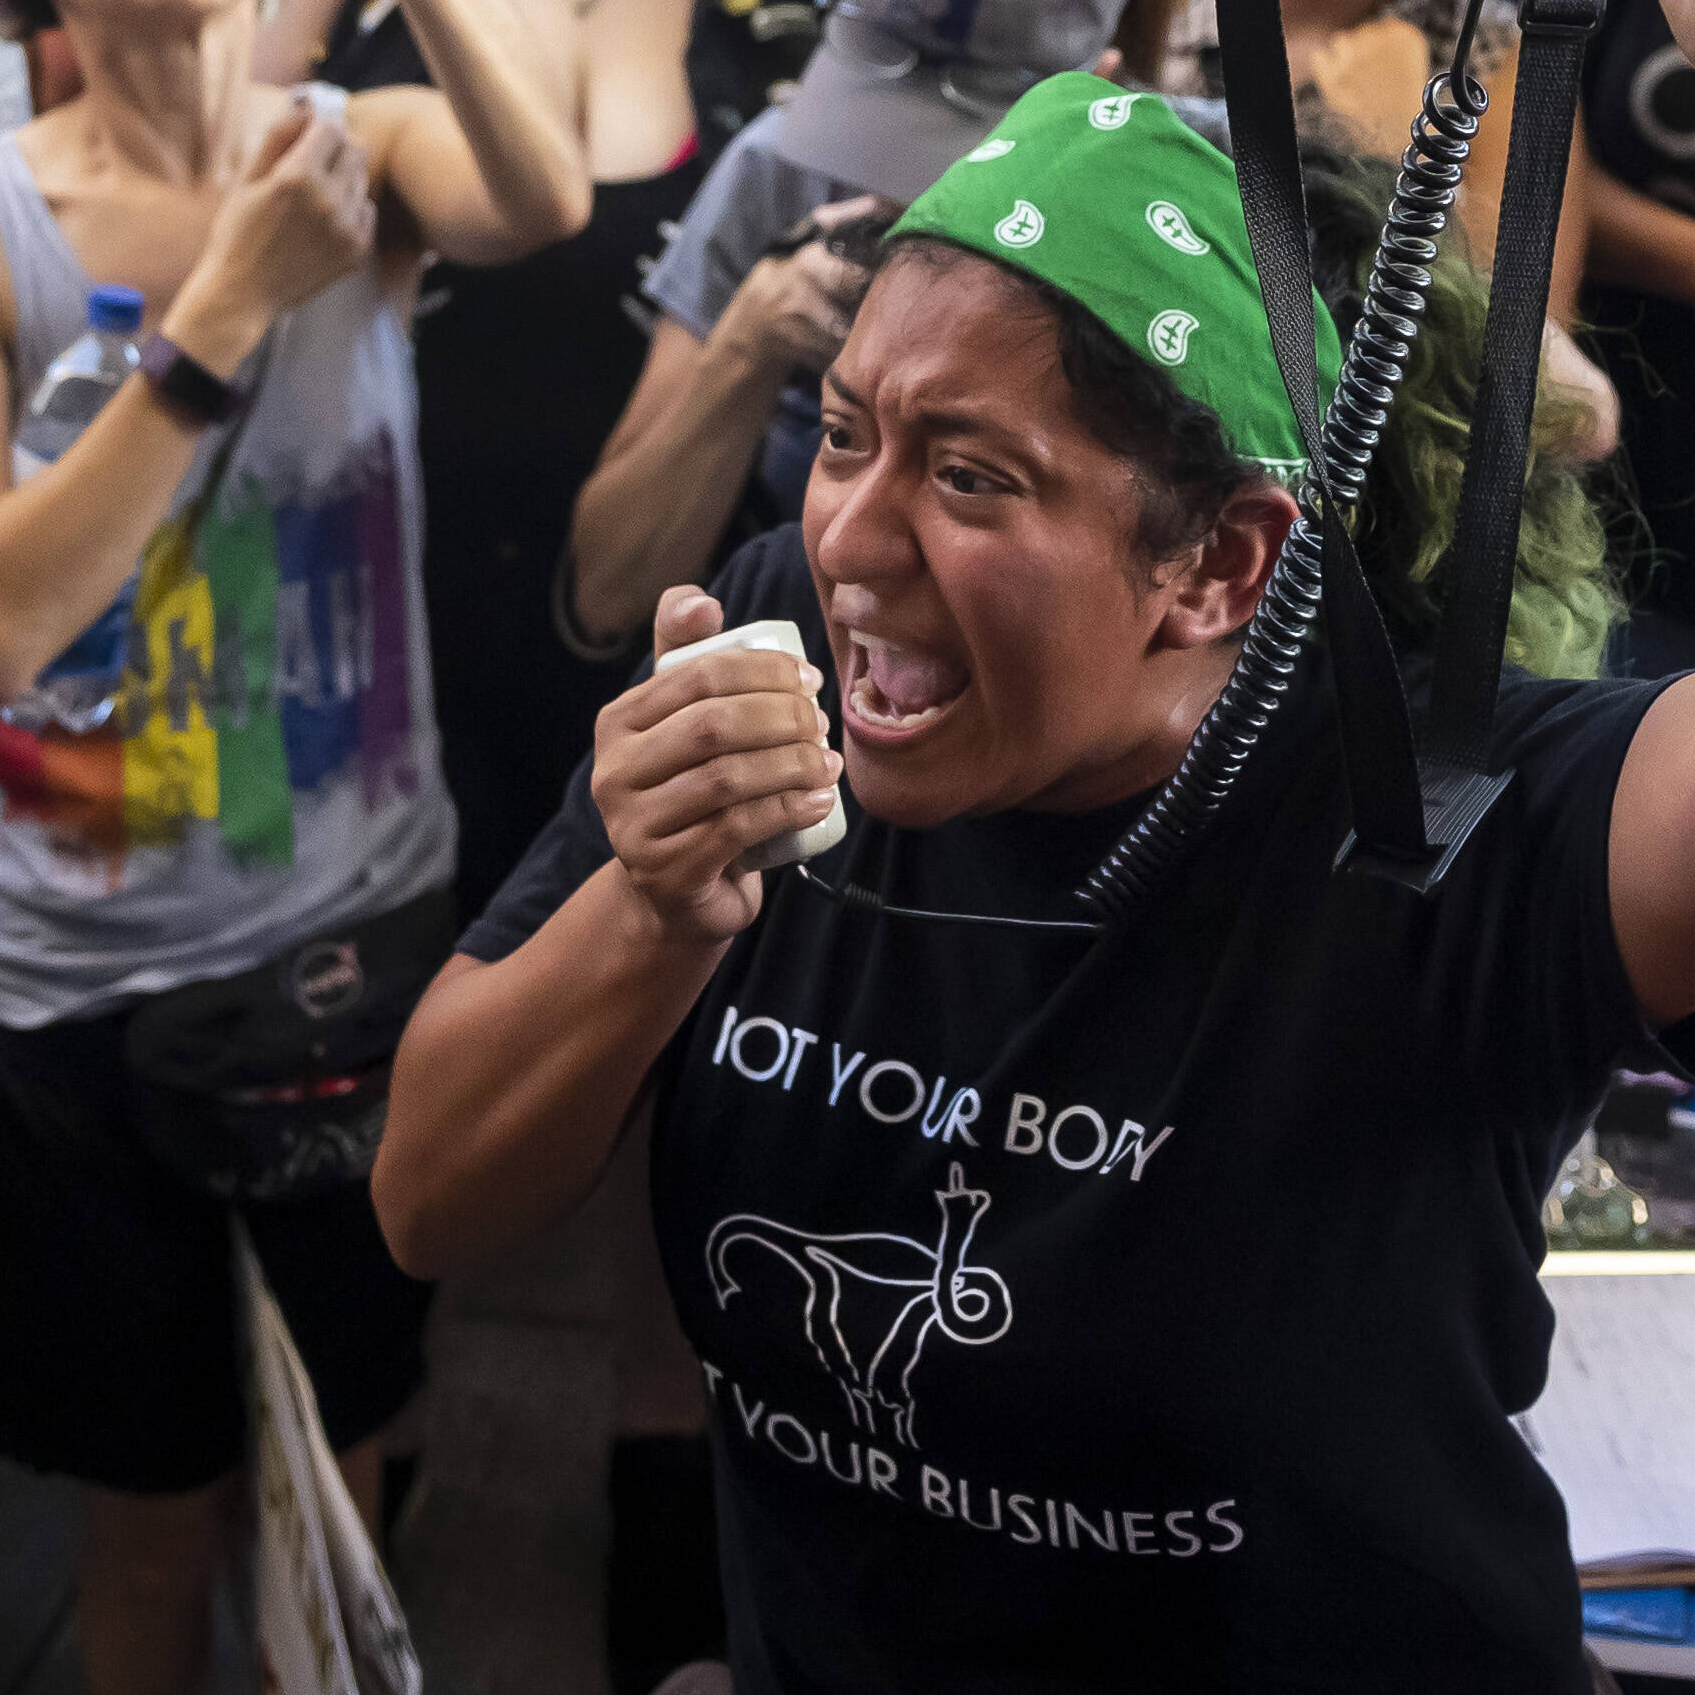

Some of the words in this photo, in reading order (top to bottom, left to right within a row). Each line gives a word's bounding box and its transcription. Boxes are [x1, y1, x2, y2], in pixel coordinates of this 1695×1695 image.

[828, 1041, 980, 1147] YOUR
[1005, 1091, 1175, 1182] BODY
[733, 1382, 904, 1500] YOUR
[920, 1463, 1244, 1558] BUSINESS
